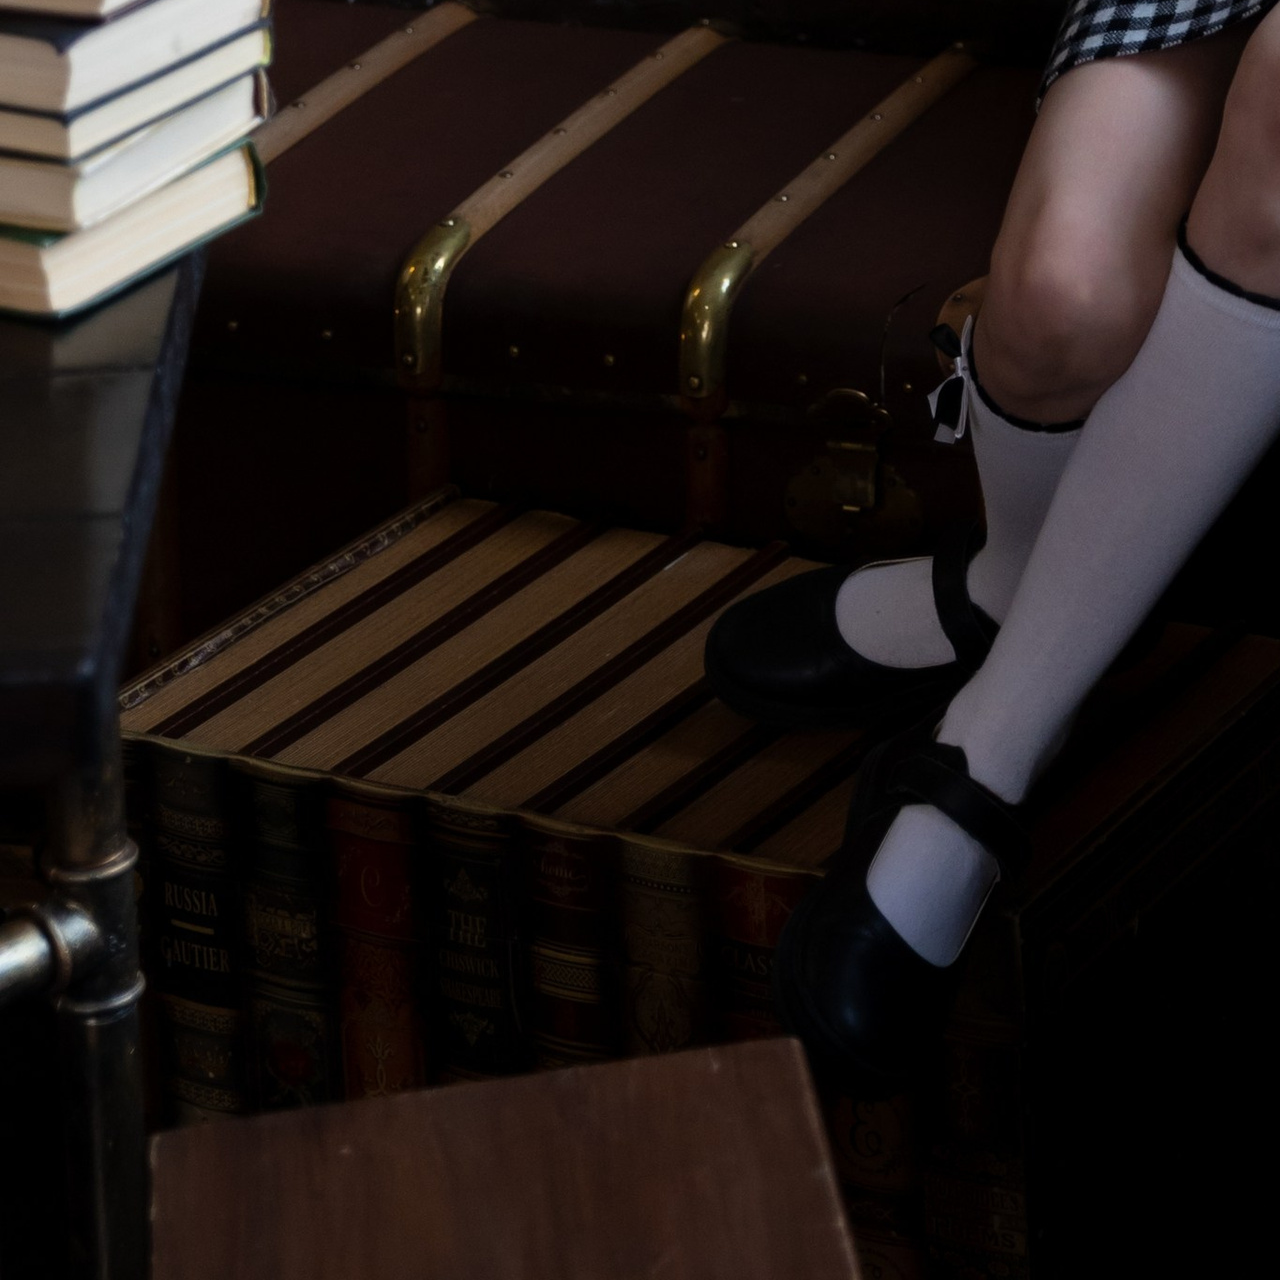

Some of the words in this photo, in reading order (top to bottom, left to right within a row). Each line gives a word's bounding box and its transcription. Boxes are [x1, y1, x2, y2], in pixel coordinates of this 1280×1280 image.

[164, 880, 218, 917] RUSSIA
[160, 934, 231, 974] GAUTIER
[438, 948, 501, 979] CHISWICK
